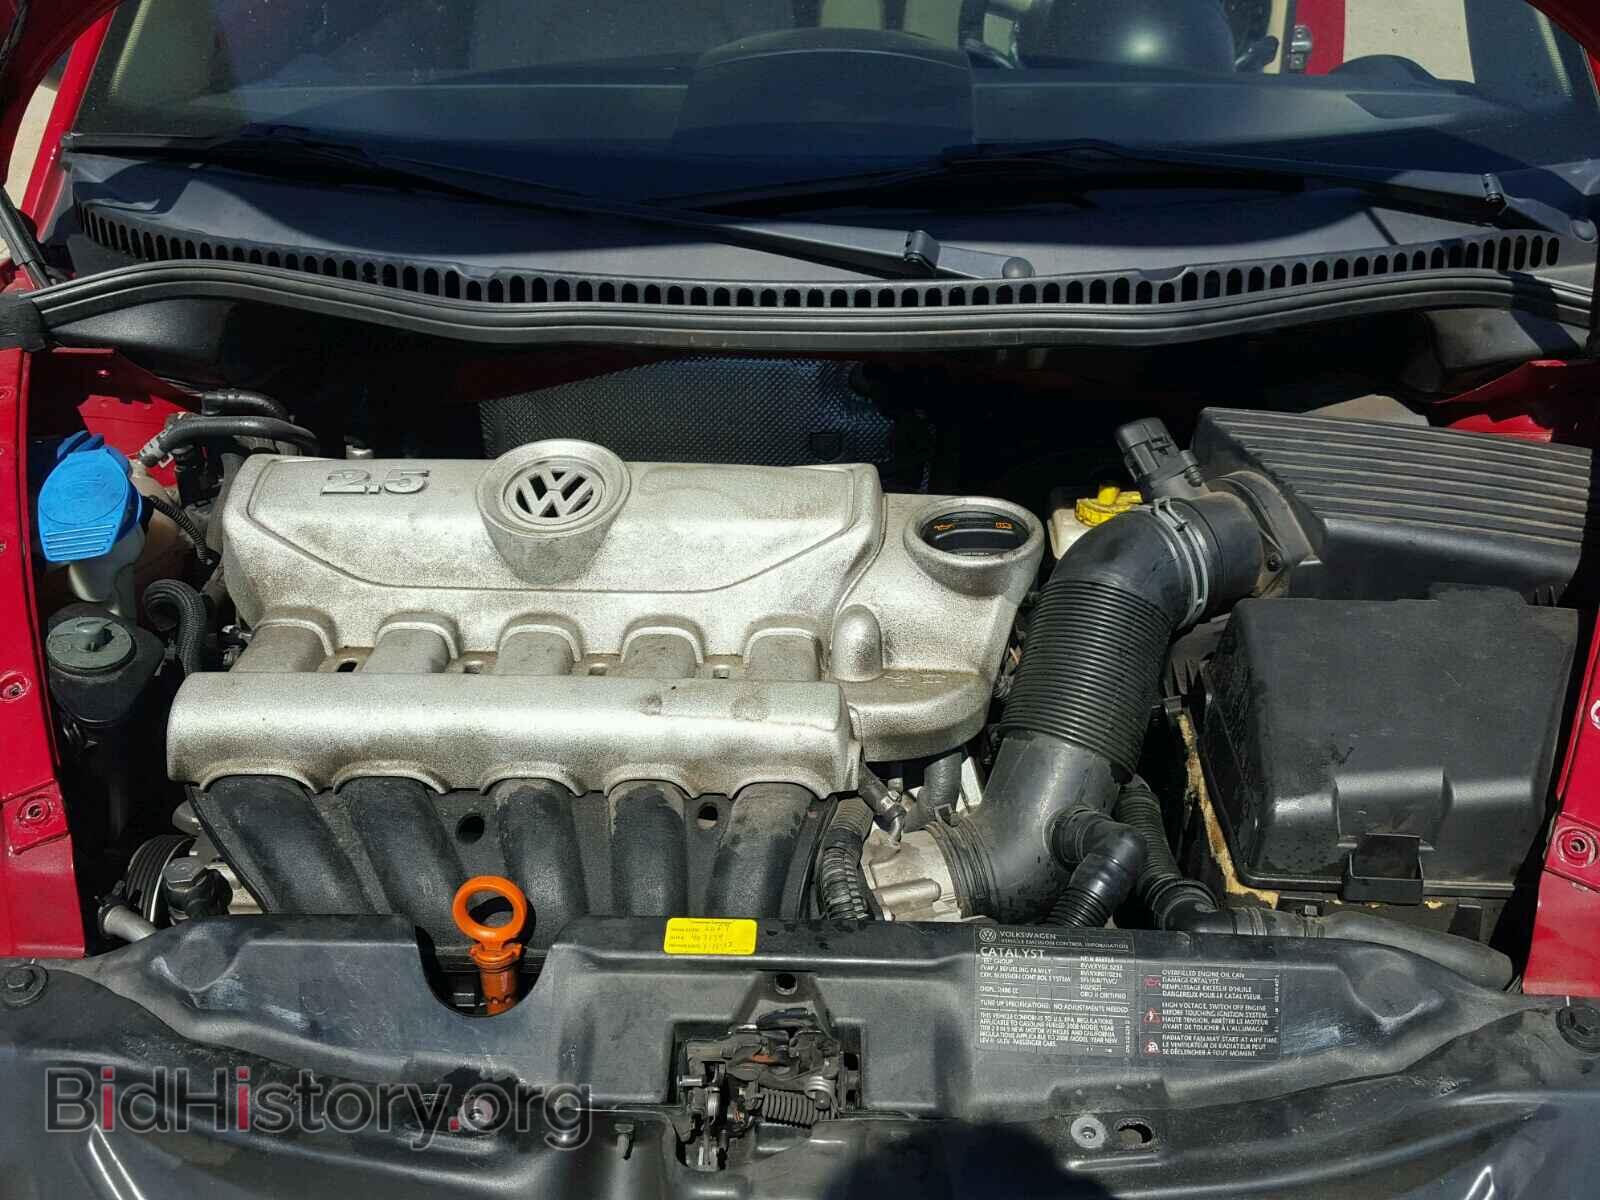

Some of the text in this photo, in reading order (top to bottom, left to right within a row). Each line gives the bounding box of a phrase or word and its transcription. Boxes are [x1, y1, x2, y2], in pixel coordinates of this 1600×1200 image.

[320, 469, 430, 496] 2.5
[1000, 930, 1056, 940] VOLKSWAGEN
[980, 947, 1045, 959] CATALYST
[1161, 969, 1196, 977] OVERFILLED
[1197, 970, 1220, 978] ENGINE
